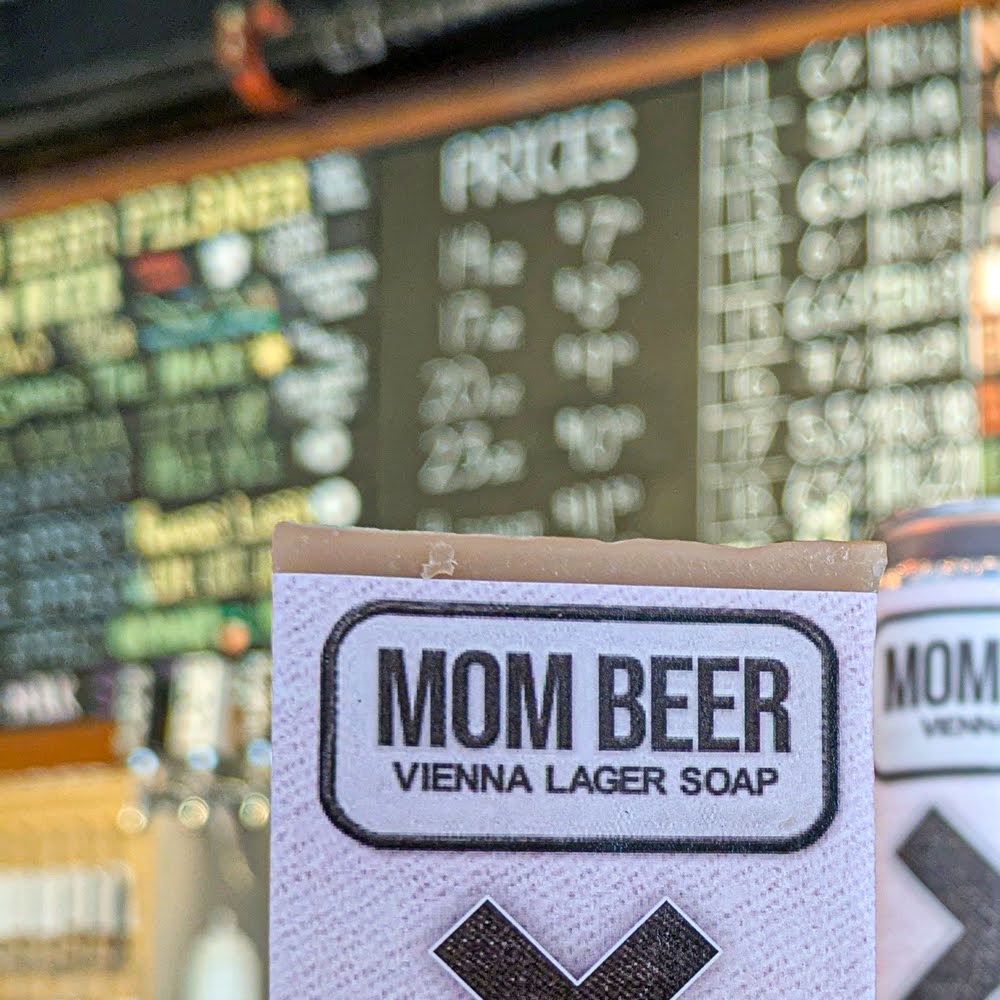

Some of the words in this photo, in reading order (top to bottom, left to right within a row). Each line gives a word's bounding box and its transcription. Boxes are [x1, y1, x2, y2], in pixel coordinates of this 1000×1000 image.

[377, 647, 573, 750] MOM
[598, 655, 792, 753] BEER
[884, 639, 999, 712] MOM
[392, 761, 533, 793] VIENNA
[545, 764, 666, 795] LAGER
[680, 766, 779, 796] SOAP
